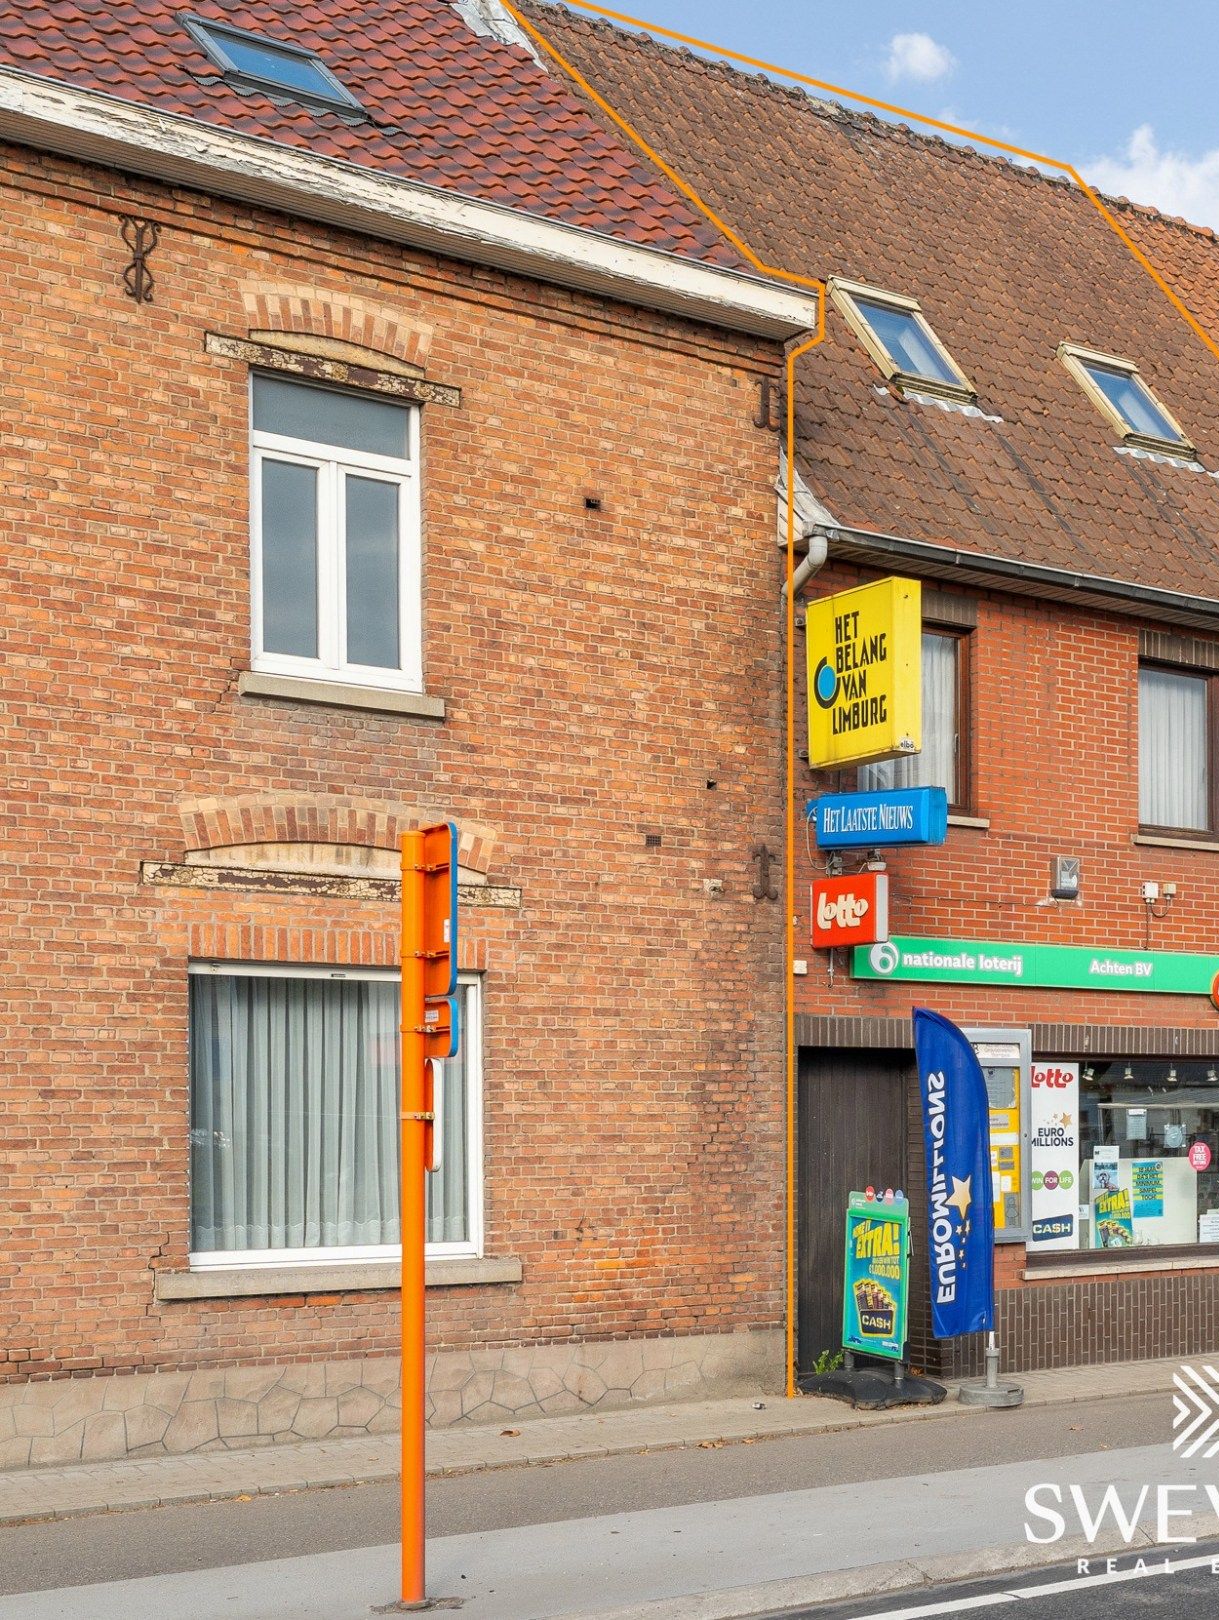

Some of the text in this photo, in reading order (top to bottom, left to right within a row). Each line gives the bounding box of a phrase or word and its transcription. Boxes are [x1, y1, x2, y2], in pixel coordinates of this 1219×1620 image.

[835, 610, 859, 644] HET
[836, 633, 887, 674] BELANG
[842, 669, 867, 703] VAN
[832, 694, 887, 735] LIMBURG
[823, 803, 914, 833] HET LAATSTE NIEUWS
[903, 951, 1022, 976] nationale loterij
[1090, 959, 1152, 976] Achten BV
[1038, 1127, 1065, 1137] EURO
[856, 1222, 900, 1259] EXTRA!
[862, 1314, 891, 1330] CASH
